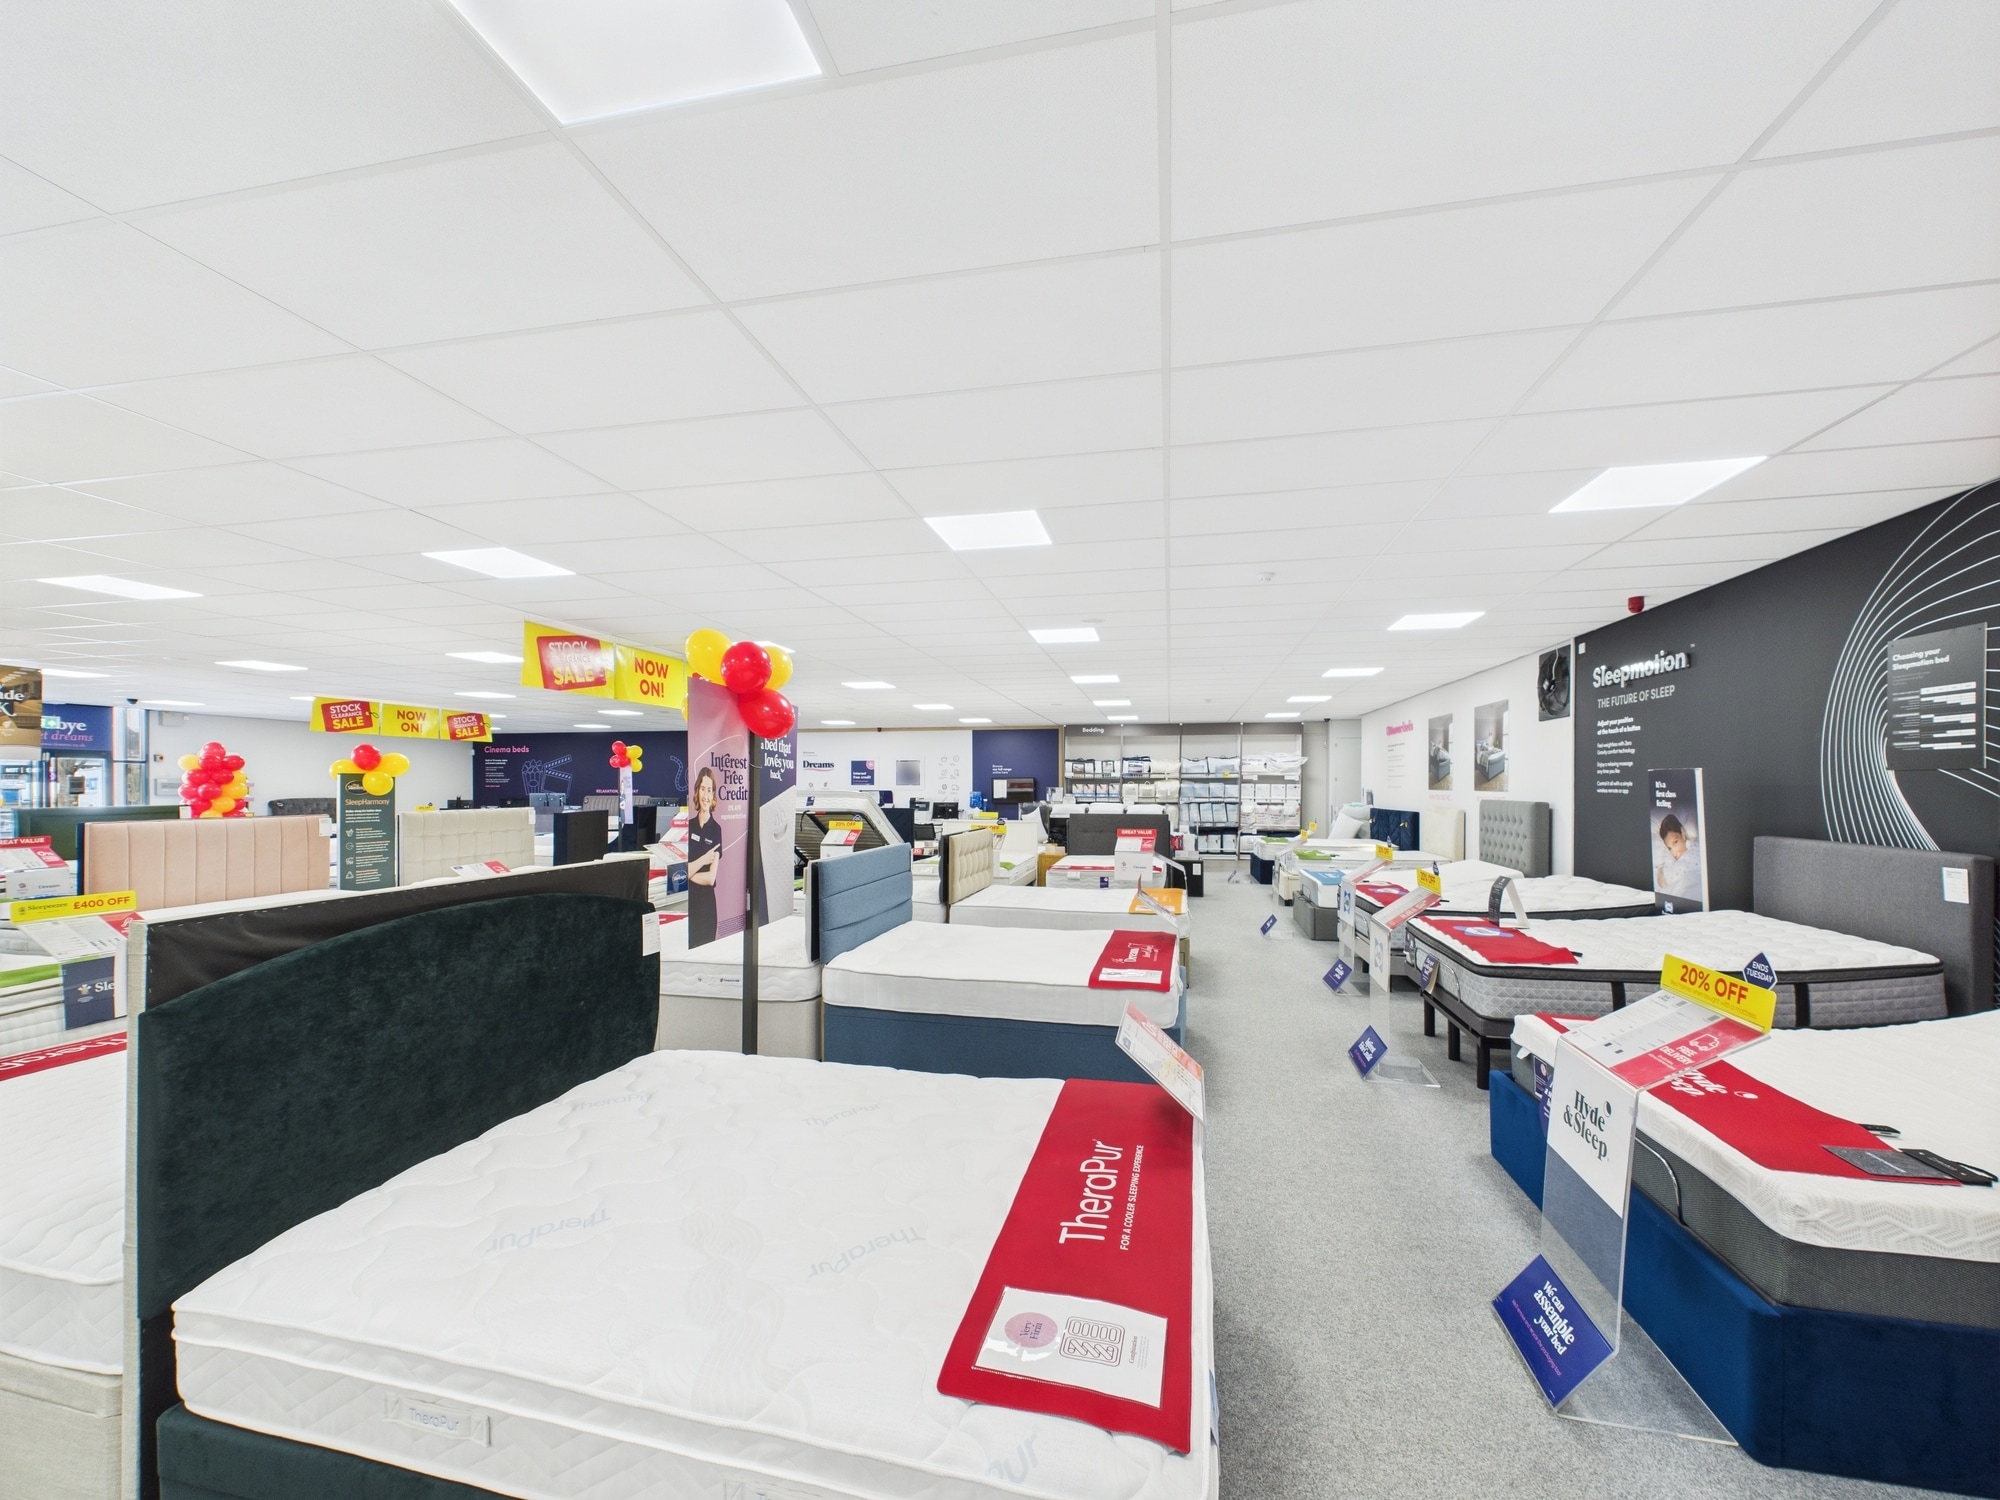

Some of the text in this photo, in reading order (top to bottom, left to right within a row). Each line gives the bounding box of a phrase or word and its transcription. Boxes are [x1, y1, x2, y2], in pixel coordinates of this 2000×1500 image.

[548, 641, 588, 653] STOCK
[1892, 648, 1941, 661] Choosing your
[547, 652, 592, 664] ARANCE
[1935, 655, 1950, 664] bed
[553, 666, 595, 685] SALE
[634, 657, 669, 679] NOW
[1593, 650, 1688, 688] Sleepmotion
[639, 679, 665, 698] ON!
[1597, 684, 1676, 709] THE FUTURE OF SLEEP
[329, 703, 361, 714] STOCK
[331, 711, 363, 719] CLEARANCE
[397, 710, 426, 722] NOW
[332, 716, 365, 730] SALE
[400, 722, 424, 733] ON!
[453, 715, 477, 726] STOCK
[51, 730, 93, 742] dreams
[455, 726, 480, 738] SALE
[484, 745, 529, 753] Cinema beds
[760, 738, 791, 756] a bed that
[710, 752, 748, 772] Interest
[764, 753, 794, 773] loves you
[803, 760, 835, 768] Dreams
[724, 770, 744, 785] Free
[718, 785, 748, 801] Credit
[73, 899, 104, 910] £400
[107, 896, 130, 906] OFF
[1746, 967, 1773, 984] TUESDAY
[1752, 961, 1769, 973] ENDS
[94, 981, 115, 993] Sle
[1680, 964, 1749, 1005] 20% OFF
[1659, 1045, 1696, 1065] DELIVERY
[1676, 1045, 1698, 1058] FREE
[1574, 1089, 1606, 1132] Hyde
[1132, 1144, 1144, 1172] EXPERIENCE
[1059, 1139, 1124, 1244] TheraPur
[1128, 1172, 1140, 1203] SLEEPING
[1124, 1203, 1136, 1228] COOLER
[486, 1207, 612, 1253] TheraPur
[1120, 1232, 1131, 1251] FOR
[808, 1226, 926, 1279] TheraPur
[1543, 1280, 1565, 1313] We can
[1533, 1289, 1575, 1345] assemble
[1019, 1320, 1033, 1337] Very
[1029, 1322, 1044, 1341] Firm
[1533, 1315, 1568, 1355] your bed
[409, 1407, 460, 1431] TheraPur
